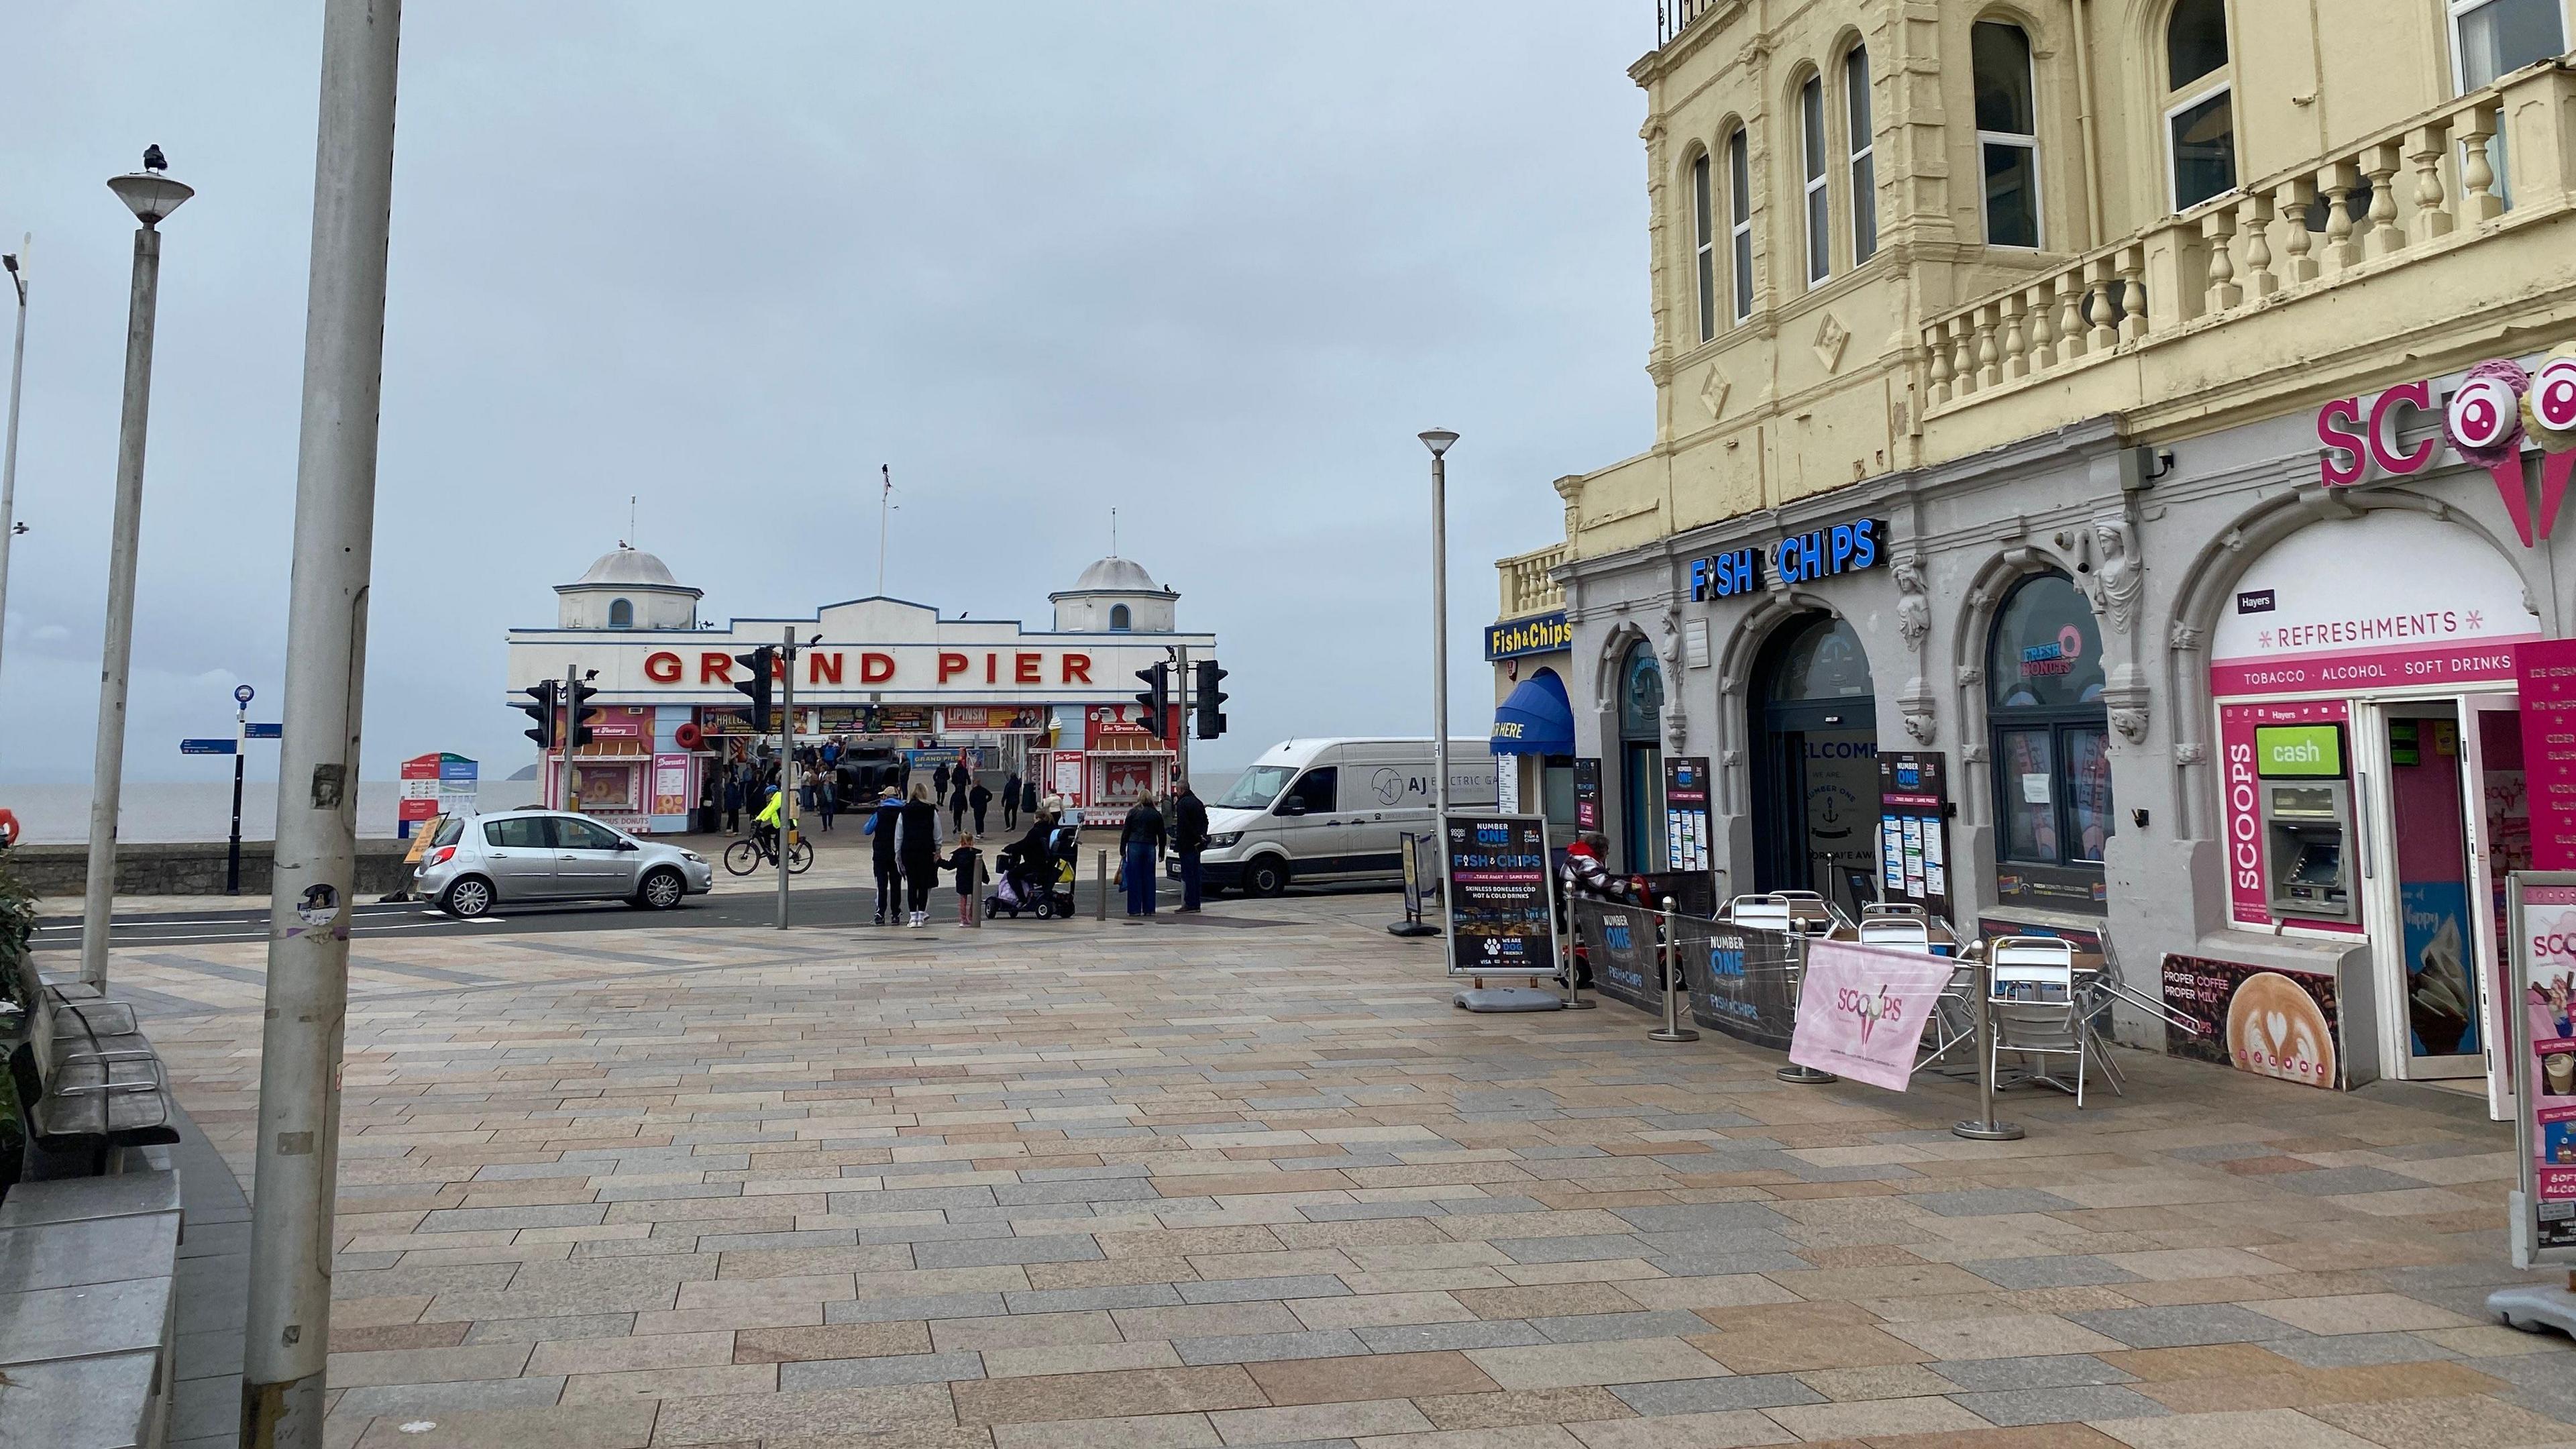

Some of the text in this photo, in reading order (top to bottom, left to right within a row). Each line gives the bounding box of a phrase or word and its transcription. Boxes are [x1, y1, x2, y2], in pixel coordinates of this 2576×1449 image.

[1690, 547, 1753, 602] FISH
[1778, 519, 1876, 584] CHIPS
[2241, 595, 2270, 608] Hayers
[2279, 611, 2457, 647] REFRESHMENTS
[2023, 643, 2061, 661] FRESH
[645, 651, 1093, 684] GRND PIER
[2021, 659, 2072, 678] DONUTS
[2244, 655, 2512, 685] TOBACCO ALCOHOL SOFT DRINKS
[2530, 668, 2546, 678] ICE
[947, 708, 987, 720] LIPINSKI
[2272, 710, 2296, 720] Hayers
[1499, 722, 1525, 739] HERE
[2545, 734, 2575, 743] CIDER
[2273, 739, 2320, 762] cash
[657, 756, 686, 767] Donuts
[1896, 762, 1919, 770] NUMBER
[1678, 772, 1692, 784] ONE
[1898, 770, 1919, 784] ONE
[1408, 777, 1427, 795] AJ
[621, 817, 649, 825] DONUTS
[2230, 743, 2259, 890] SCOOPS
[1477, 830, 1509, 843] ONE
[1454, 854, 1541, 867] FISH & CHIPS
[1603, 915, 1629, 926] NUMBER
[1606, 927, 1632, 951] ONE
[1710, 936, 1744, 949] NUMBER
[1711, 950, 1745, 976] ONE
[1625, 971, 1642, 988] CHIPS
[2164, 971, 2229, 991] PROPER COFFEE
[2165, 985, 2218, 1004] PROPER MILK
[1733, 1000, 1759, 1020] CHIPS
[1837, 985, 1902, 1022] SCOOPS
